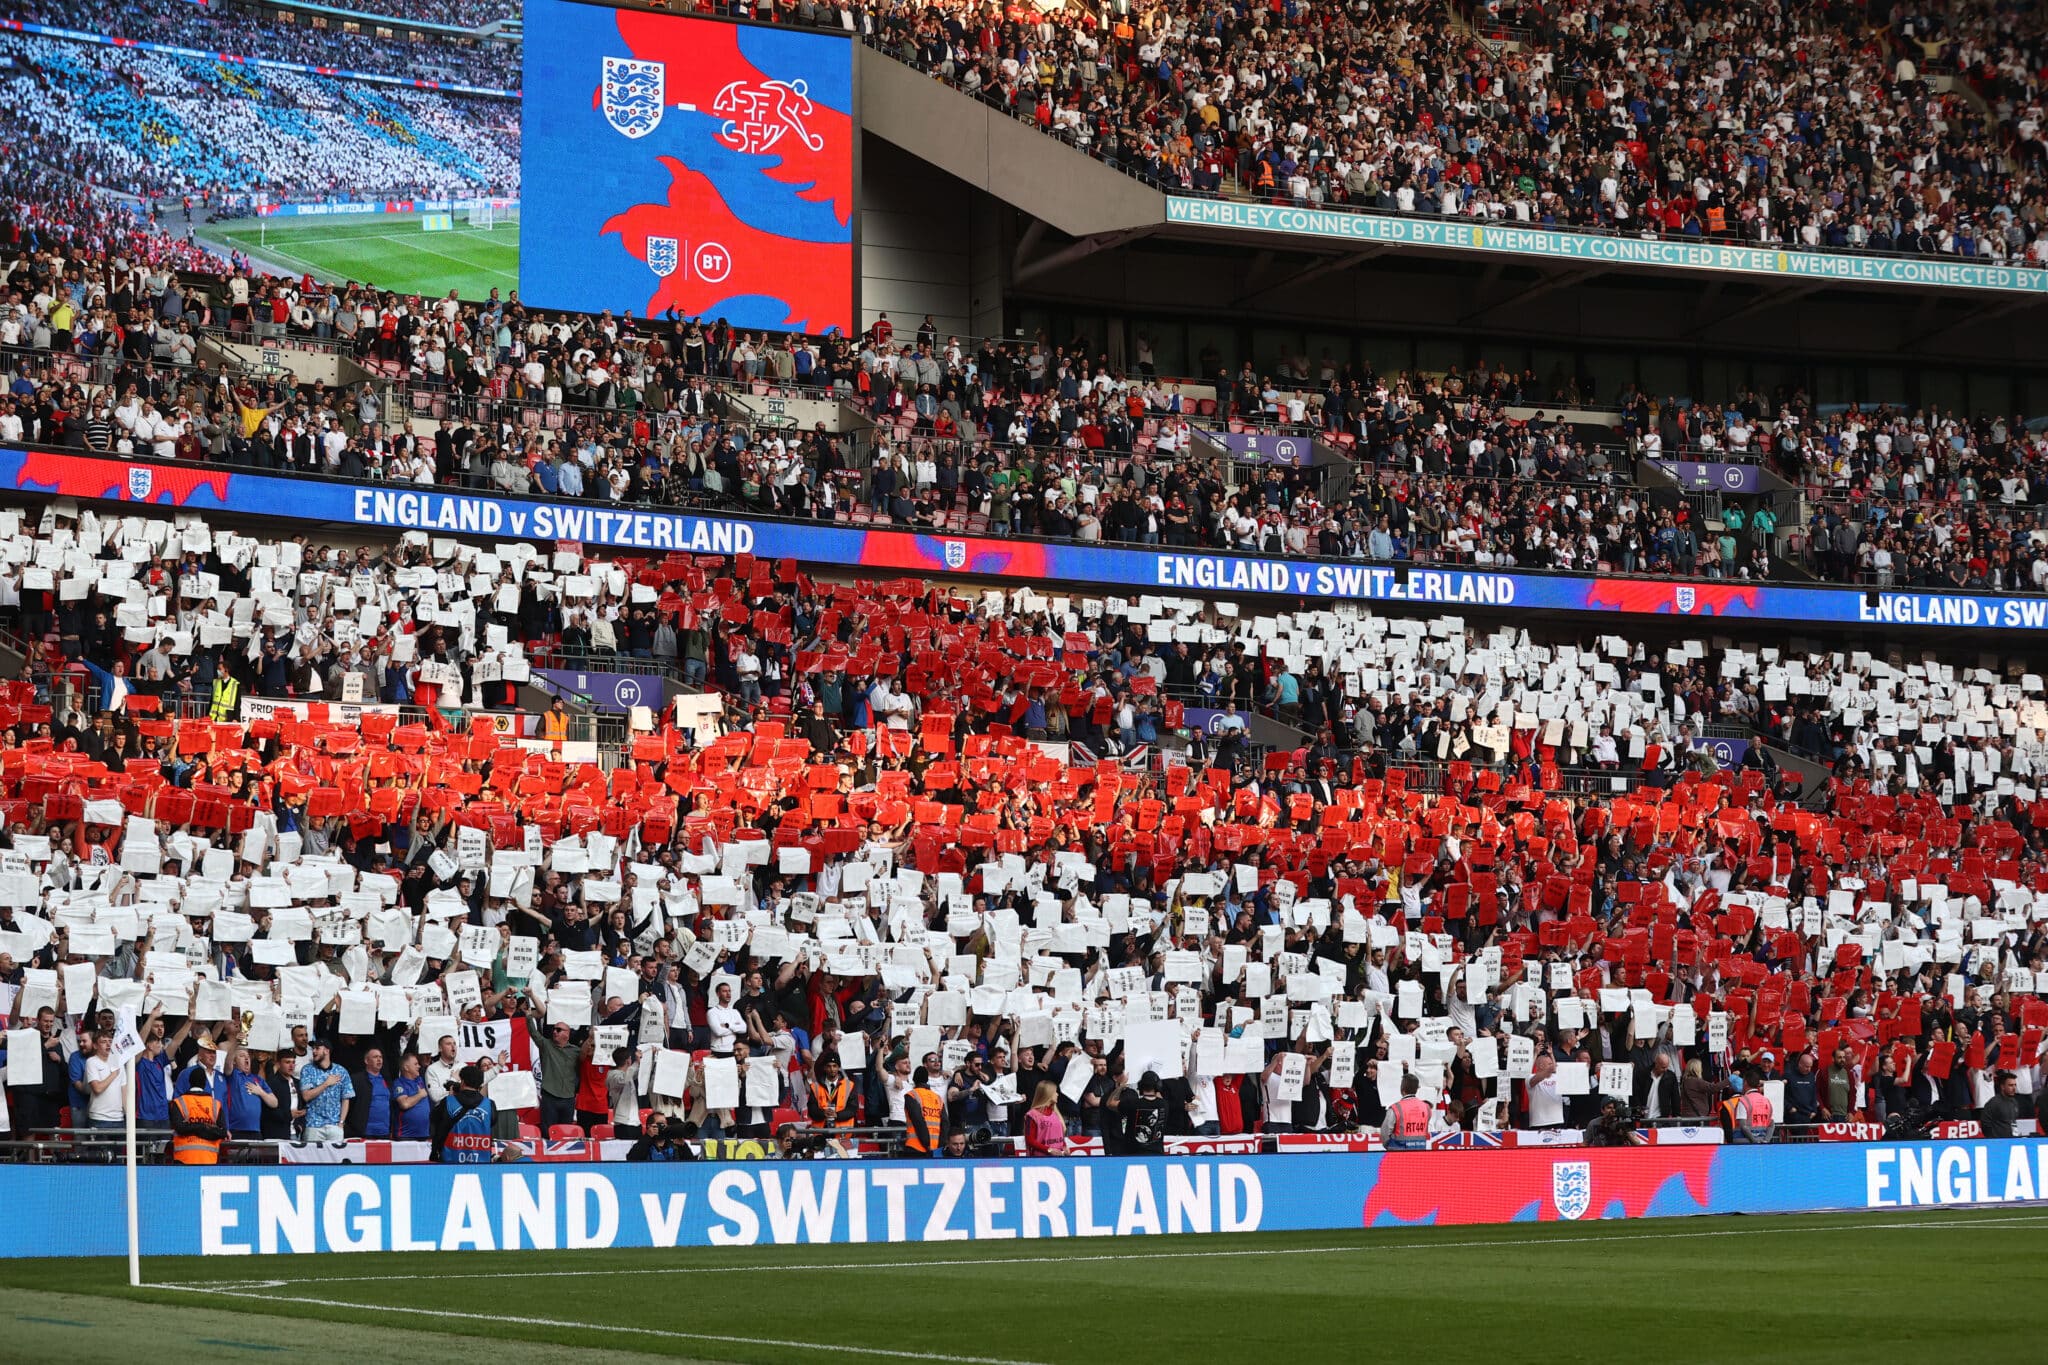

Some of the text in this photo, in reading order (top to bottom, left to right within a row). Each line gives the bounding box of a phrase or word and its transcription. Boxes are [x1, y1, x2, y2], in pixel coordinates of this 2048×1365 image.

[1168, 201, 1468, 245] WEMBLEY CONNECTED BY EE
[1487, 229, 1774, 270] WEMBLEY CONNECTED BY EE
[702, 255, 723, 271] BT
[1791, 255, 2042, 288] WEMBLEY CONNECTED BY
[263, 353, 279, 363] 213
[769, 402, 784, 412] 214
[1280, 446, 1292, 455] BT
[1728, 473, 1739, 482] BT
[354, 489, 754, 554] ENGLAND v SWITZERLAND
[1158, 556, 1289, 592] ENGLAND
[1295, 573, 1311, 593] v
[1859, 594, 1979, 625] ENGLAND
[1984, 606, 1999, 626] v
[621, 687, 636, 699] BT
[457, 1025, 497, 1049] ILS
[453, 1135, 491, 1149] PHOTO
[458, 1151, 479, 1164] 047
[201, 1162, 1263, 1255] ENGLAND v SWITZERLAND
